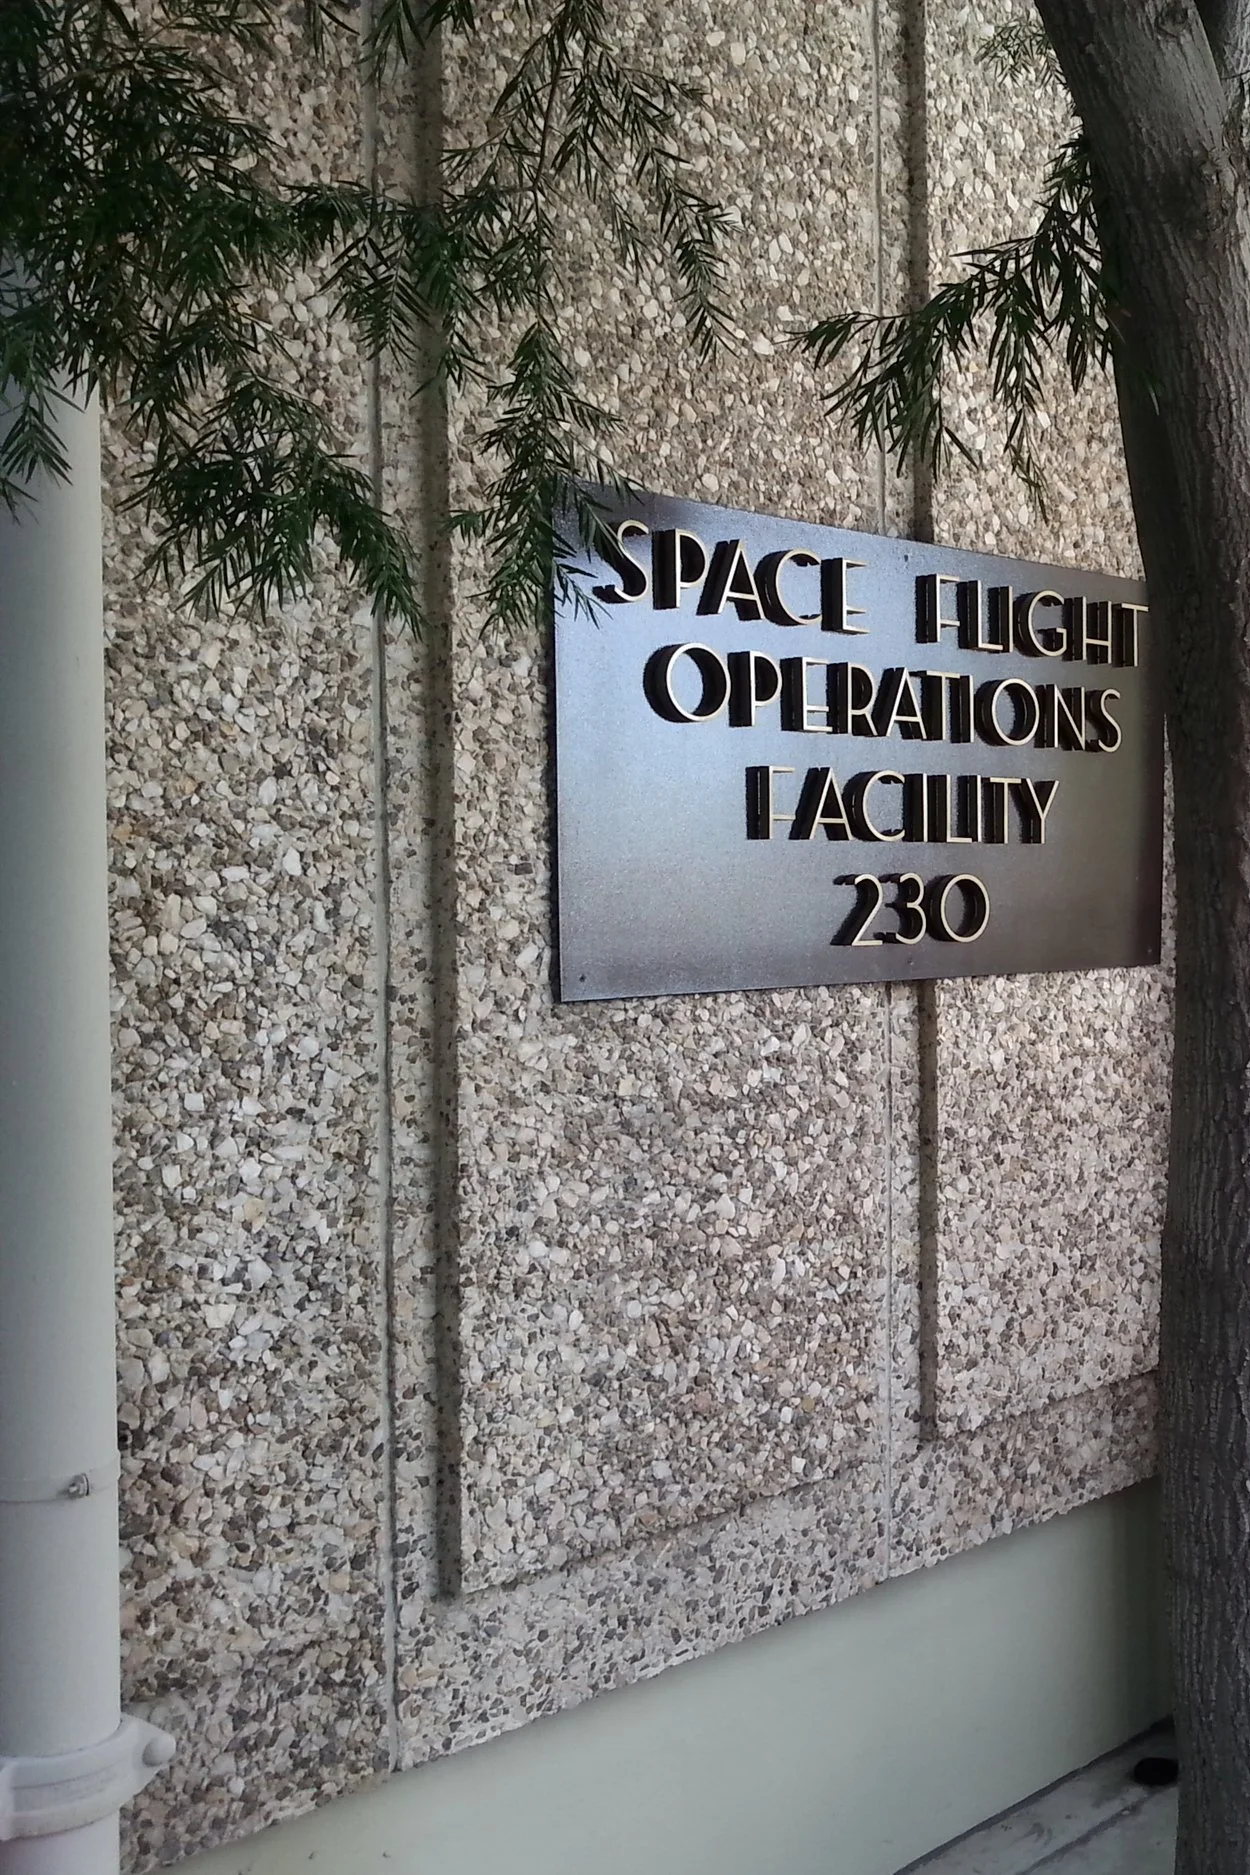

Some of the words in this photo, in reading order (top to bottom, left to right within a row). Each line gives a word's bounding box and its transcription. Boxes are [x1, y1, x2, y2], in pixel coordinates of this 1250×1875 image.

[595, 519, 869, 636] SPACE
[916, 573, 1149, 668] FLIGHT
[644, 642, 1122, 753] OPERATIONS
[746, 765, 1059, 845] FACILITY
[833, 873, 991, 946] 230
